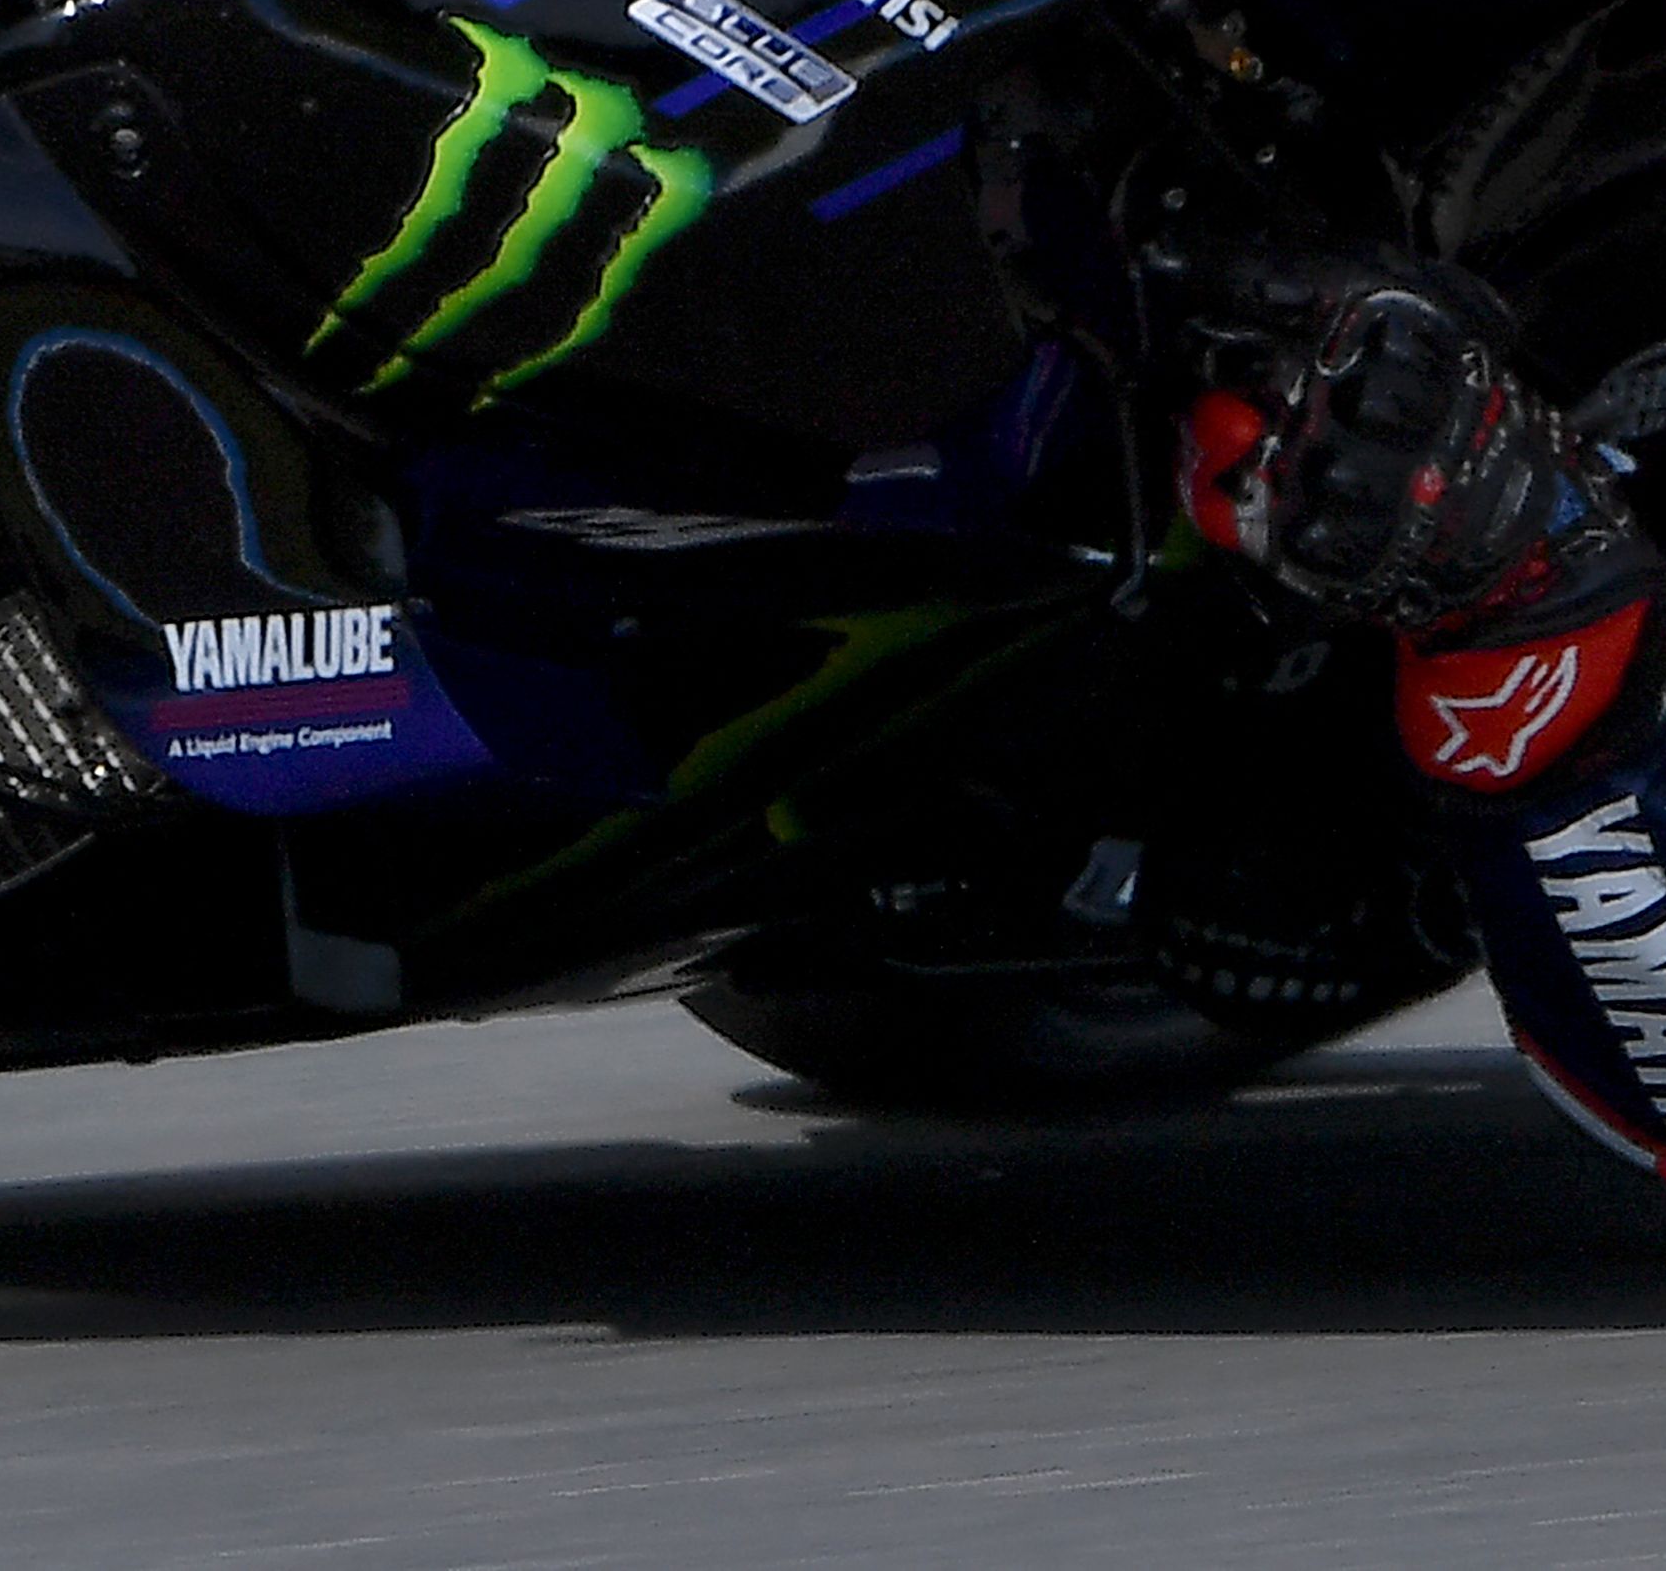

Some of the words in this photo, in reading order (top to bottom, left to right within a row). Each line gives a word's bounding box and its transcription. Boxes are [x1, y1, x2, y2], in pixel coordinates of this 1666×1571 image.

[163, 604, 395, 693] YAMALUBE
[167, 737, 183, 758] A
[185, 732, 237, 760] Liquid
[239, 730, 295, 755] Engine
[297, 720, 393, 749] Component
